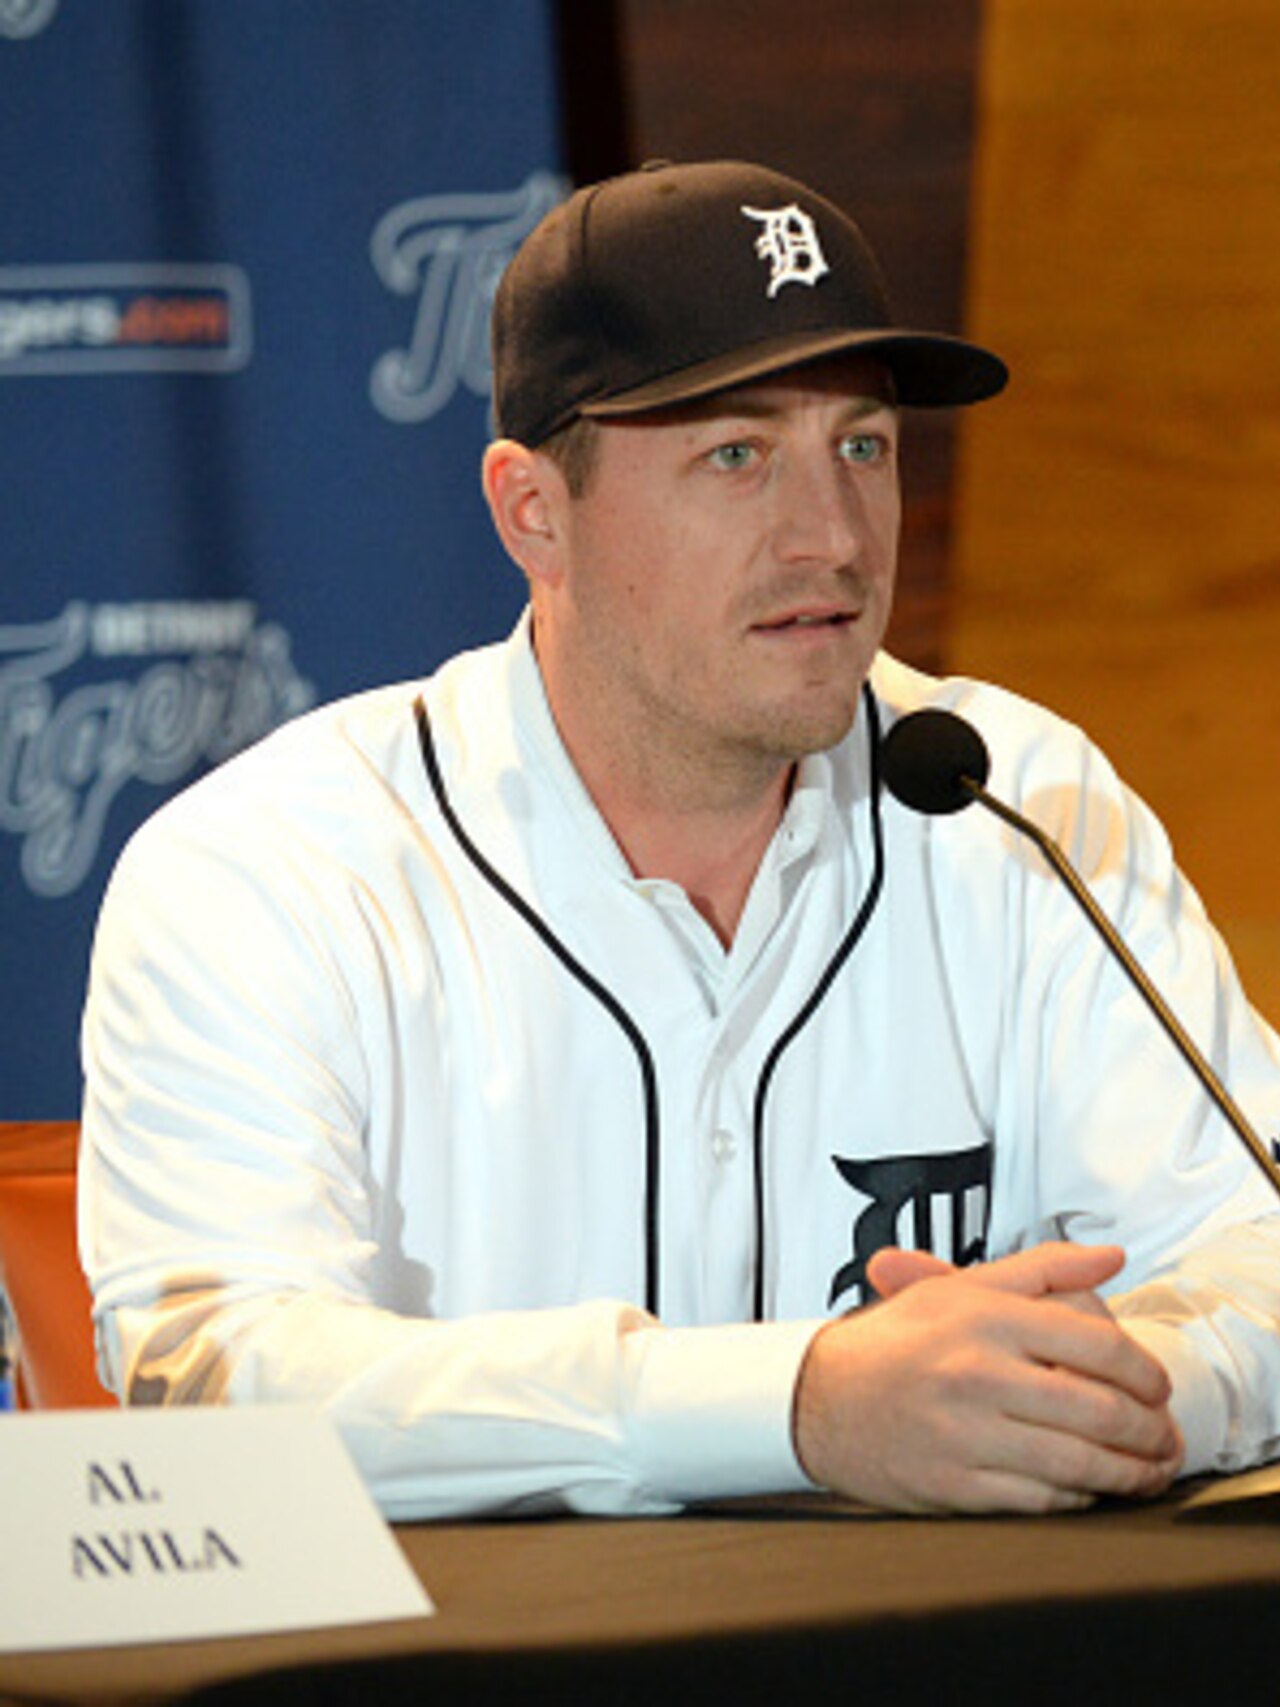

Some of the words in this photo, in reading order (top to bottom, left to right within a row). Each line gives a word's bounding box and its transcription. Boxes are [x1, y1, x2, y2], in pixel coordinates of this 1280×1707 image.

[741, 204, 829, 298] D
[87, 1459, 161, 1505] AL
[72, 1528, 243, 1579] AVILA
